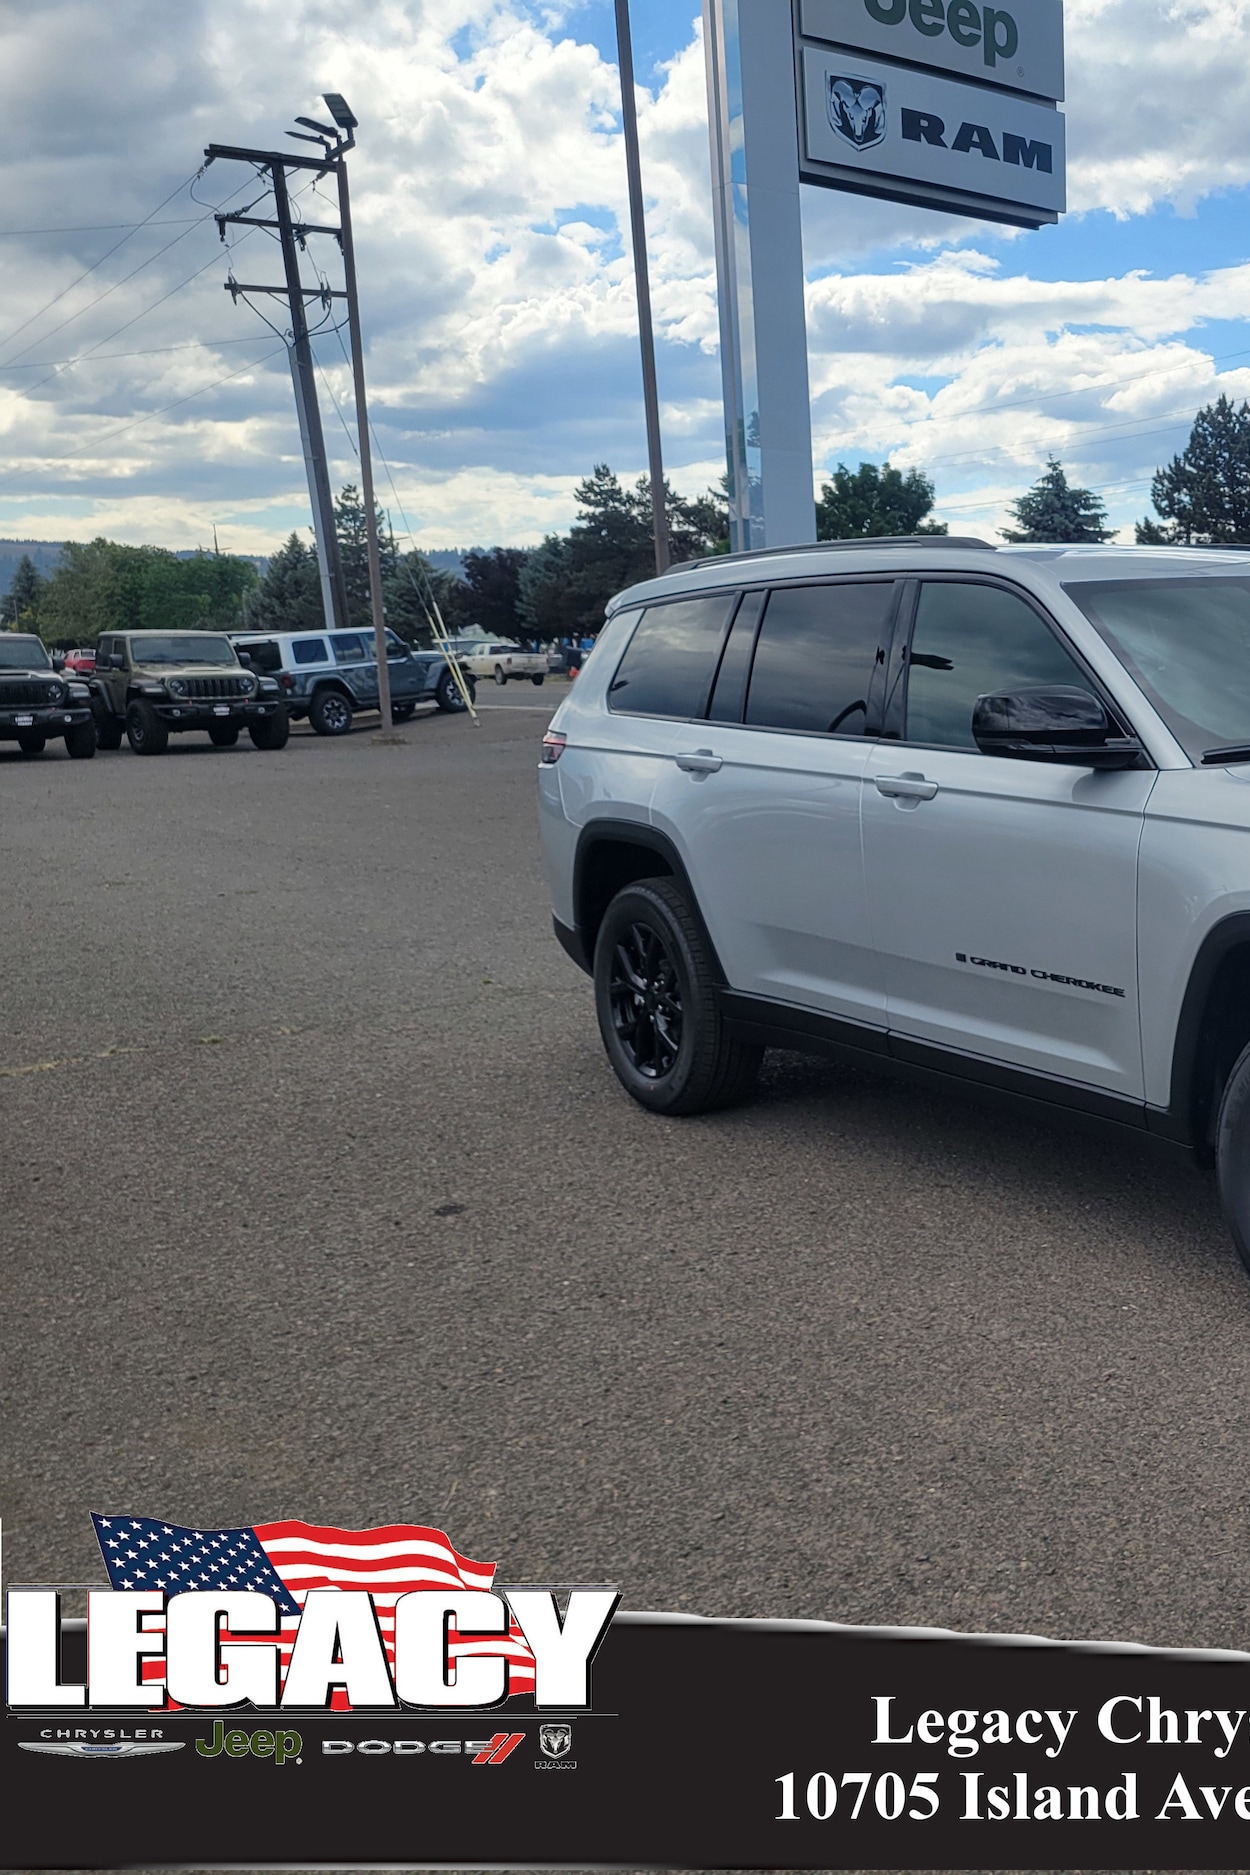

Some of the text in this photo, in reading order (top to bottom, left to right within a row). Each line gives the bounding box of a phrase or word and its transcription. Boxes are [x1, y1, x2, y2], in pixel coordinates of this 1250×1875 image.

[901, 107, 1052, 174] RAM
[970, 956, 1126, 998] GRAND CHEROKEE
